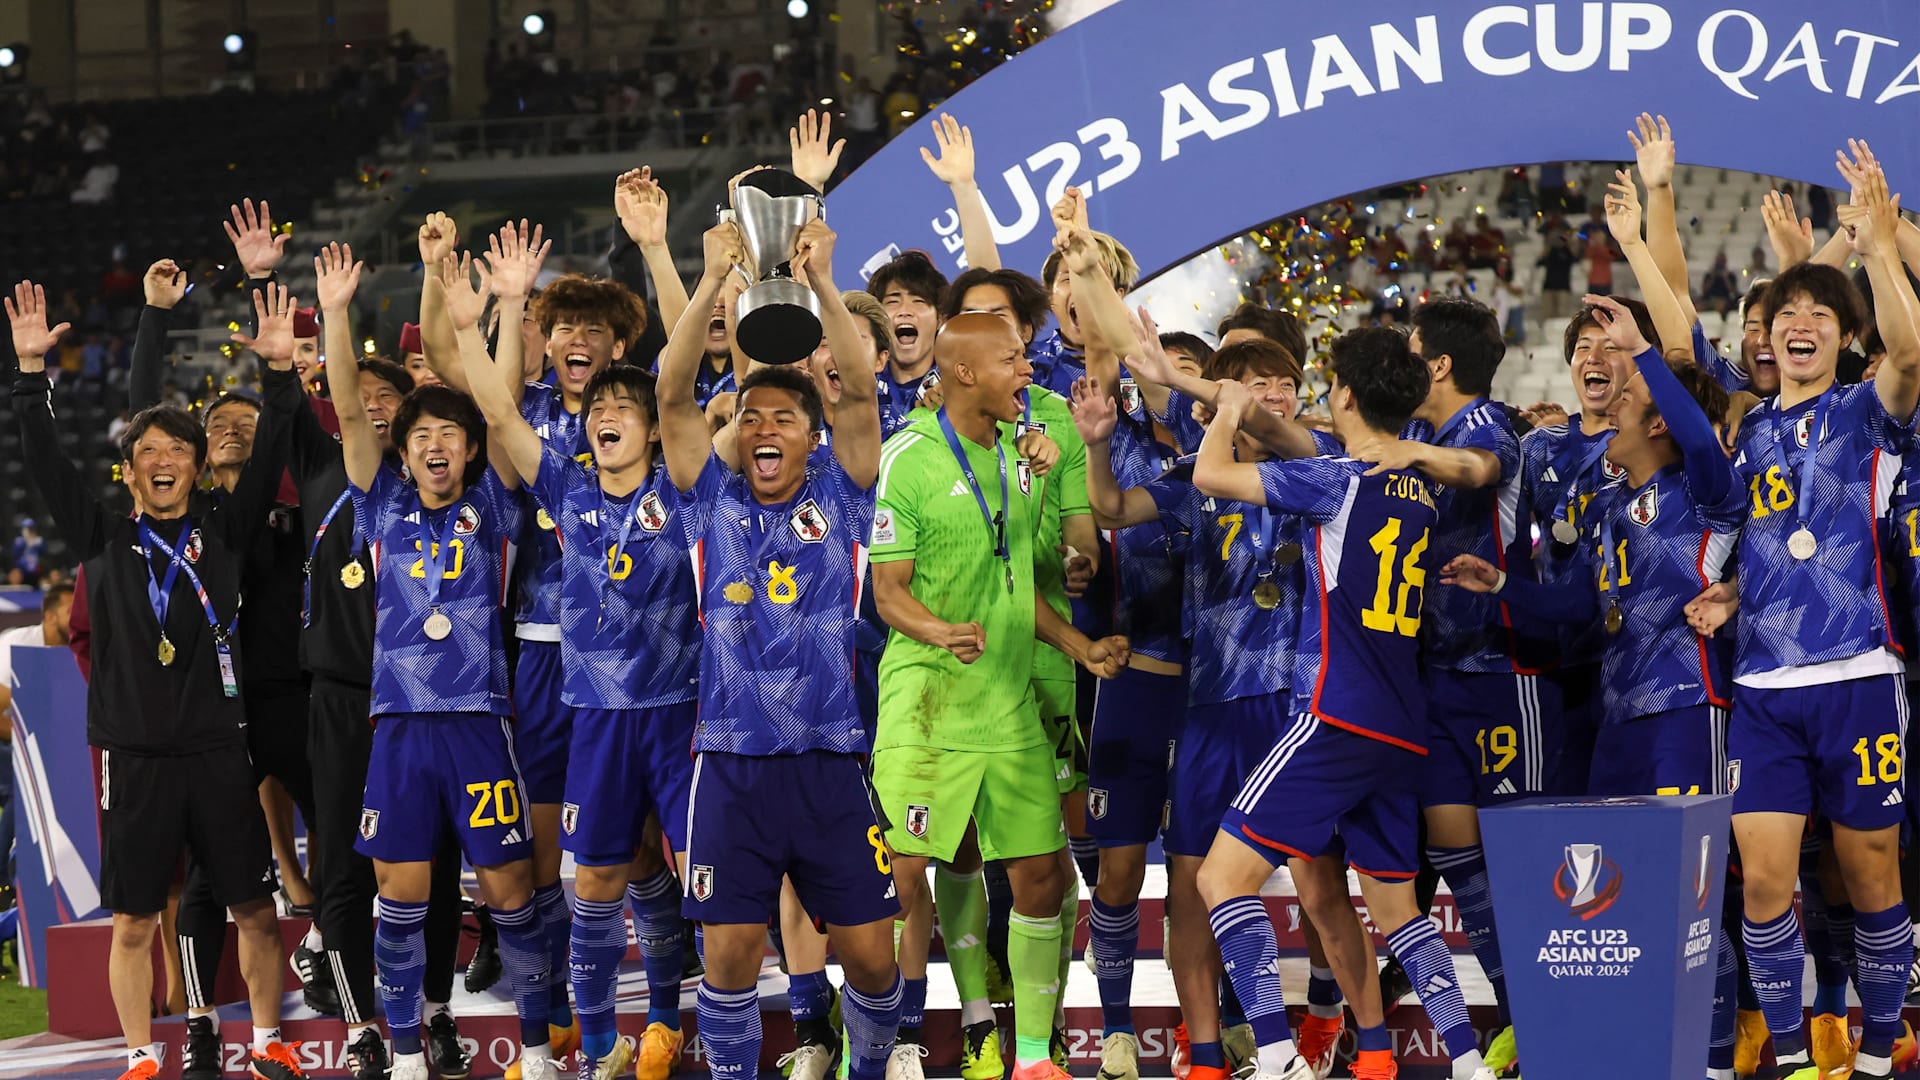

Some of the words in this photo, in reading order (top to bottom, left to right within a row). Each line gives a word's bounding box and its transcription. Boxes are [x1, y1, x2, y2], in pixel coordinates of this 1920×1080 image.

[975, 118, 1141, 245] U23
[1160, 15, 1444, 162] ASIAN
[1462, 2, 1673, 76] CUP
[1750, 465, 1795, 519] 18
[1218, 513, 1244, 561] 7
[767, 560, 798, 605] 8
[1361, 517, 1430, 638] 16
[1475, 725, 1518, 775] 19
[1852, 732, 1902, 786] 18
[466, 779, 520, 829] 20
[867, 824, 892, 875] 8
[1537, 947, 1597, 962] ASIAN
[1600, 946, 1641, 962] CUP
[1547, 929, 1588, 945] AFC
[1591, 929, 1628, 945] U23
[1549, 964, 1594, 979] QATAR
